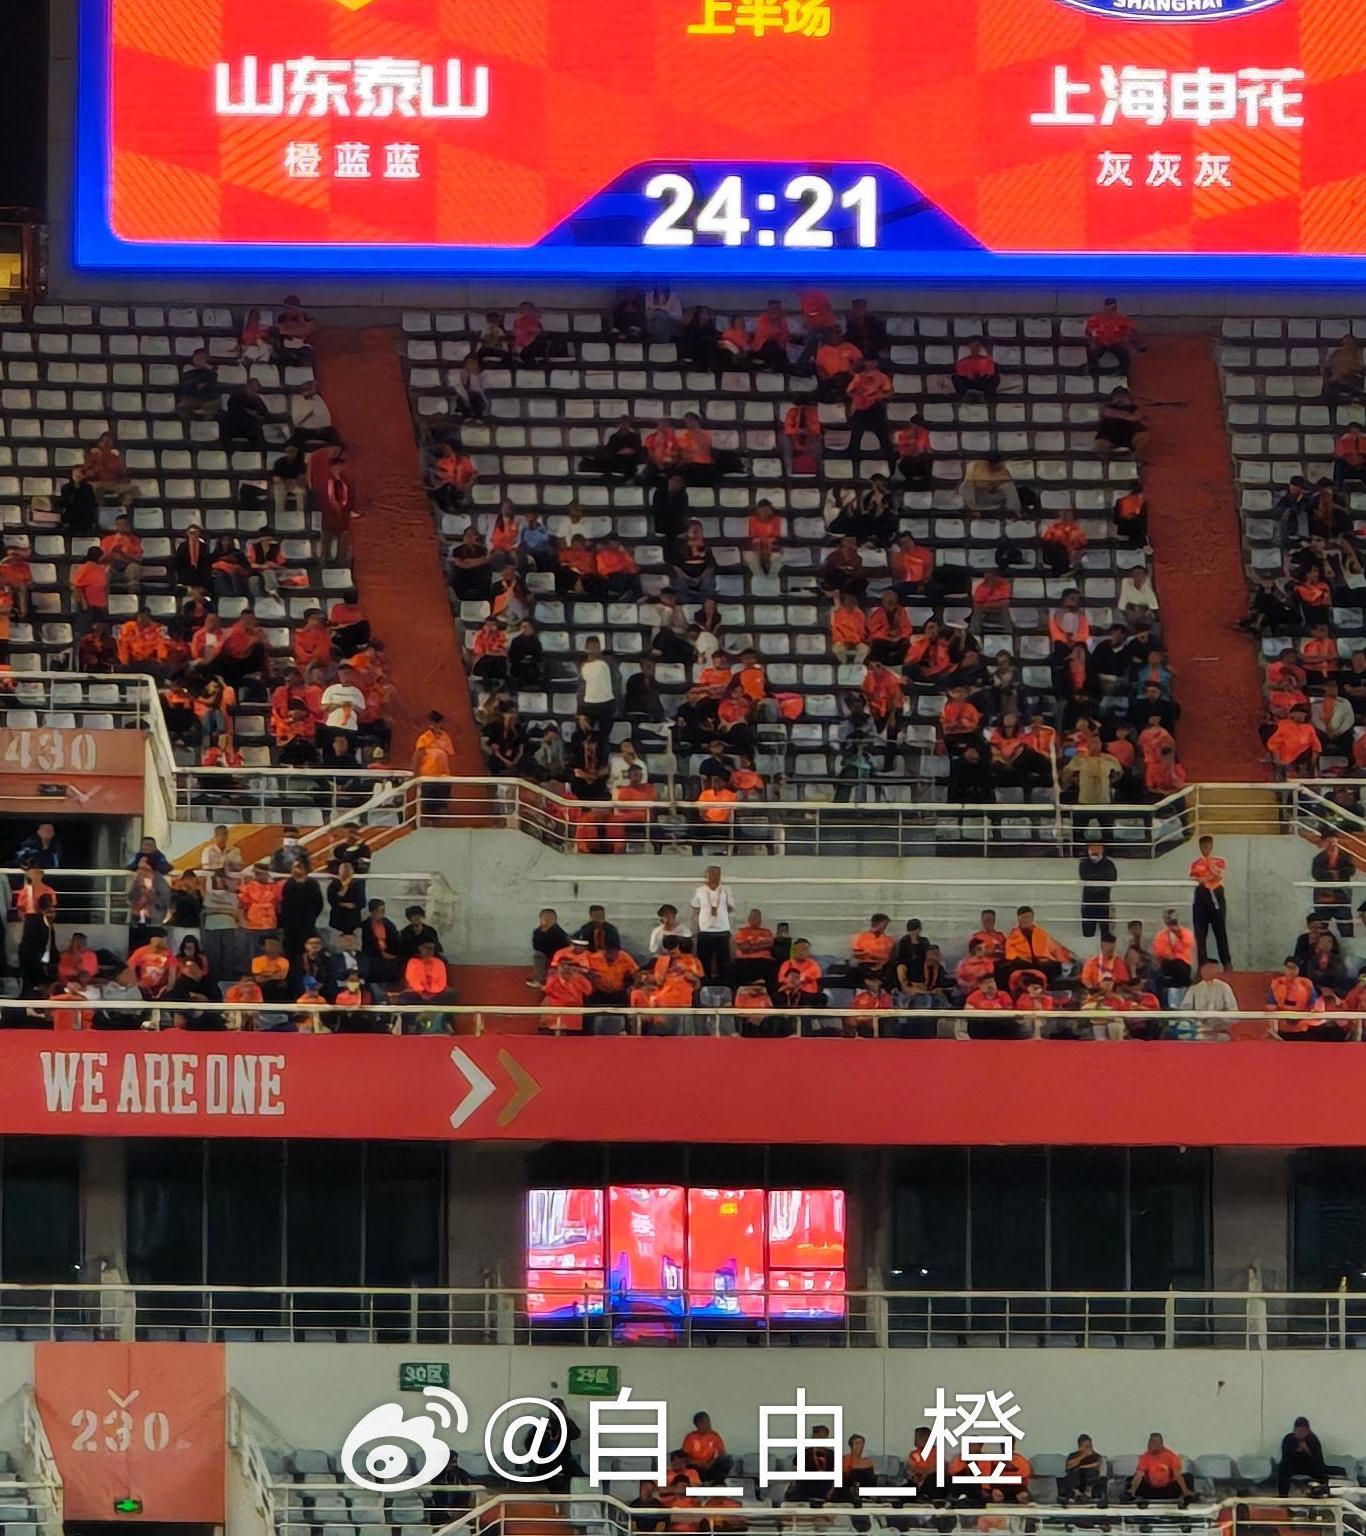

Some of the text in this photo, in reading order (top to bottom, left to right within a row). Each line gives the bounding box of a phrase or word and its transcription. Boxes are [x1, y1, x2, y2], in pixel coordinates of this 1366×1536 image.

[214, 55, 489, 119] 山东泰山
[1030, 64, 1306, 128] 上海申花
[642, 172, 877, 249] 24:21
[4, 730, 97, 771] 430
[39, 1051, 285, 1115] WE ARE ONE
[70, 1409, 170, 1452] 230
